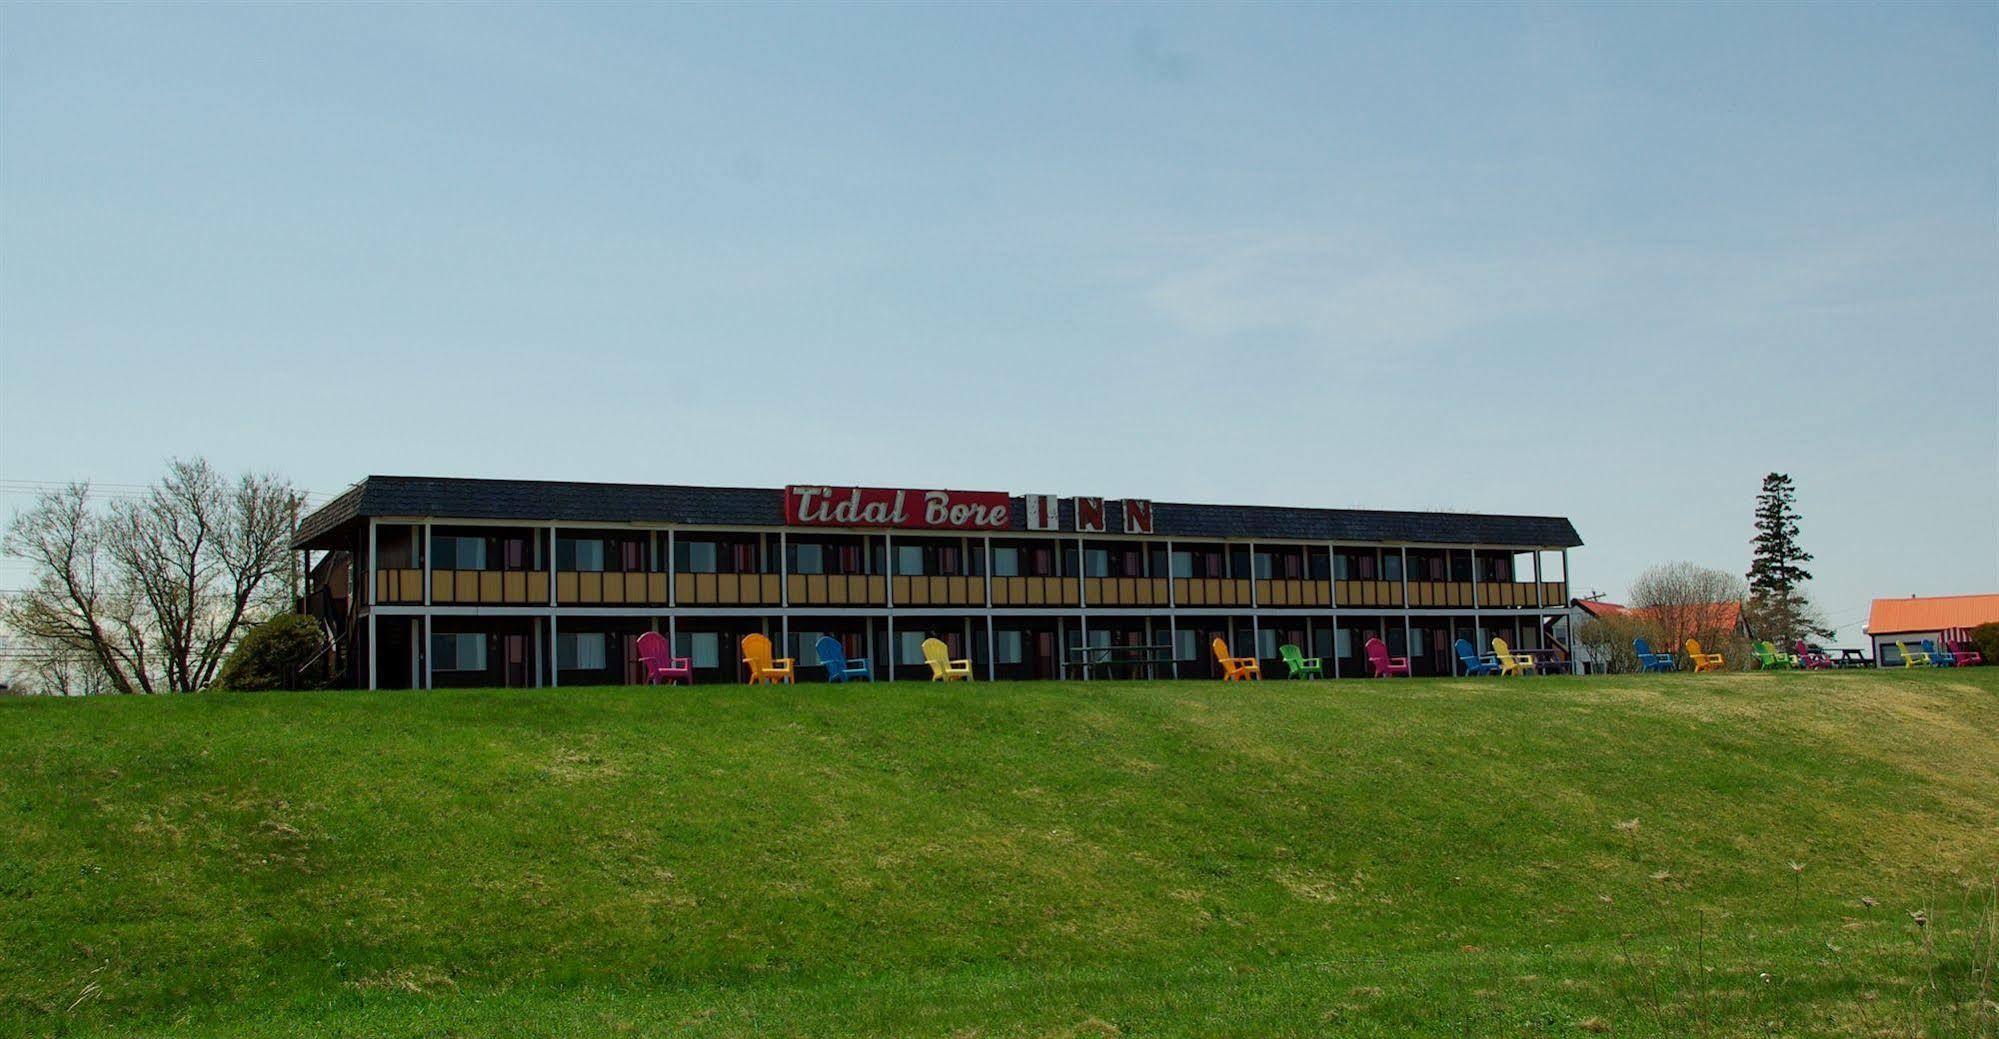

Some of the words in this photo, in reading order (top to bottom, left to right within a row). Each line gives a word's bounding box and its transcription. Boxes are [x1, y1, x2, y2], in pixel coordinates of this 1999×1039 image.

[792, 486, 909, 523] Tidal
[924, 491, 1009, 526] Bore
[1034, 495, 1152, 532] INN
